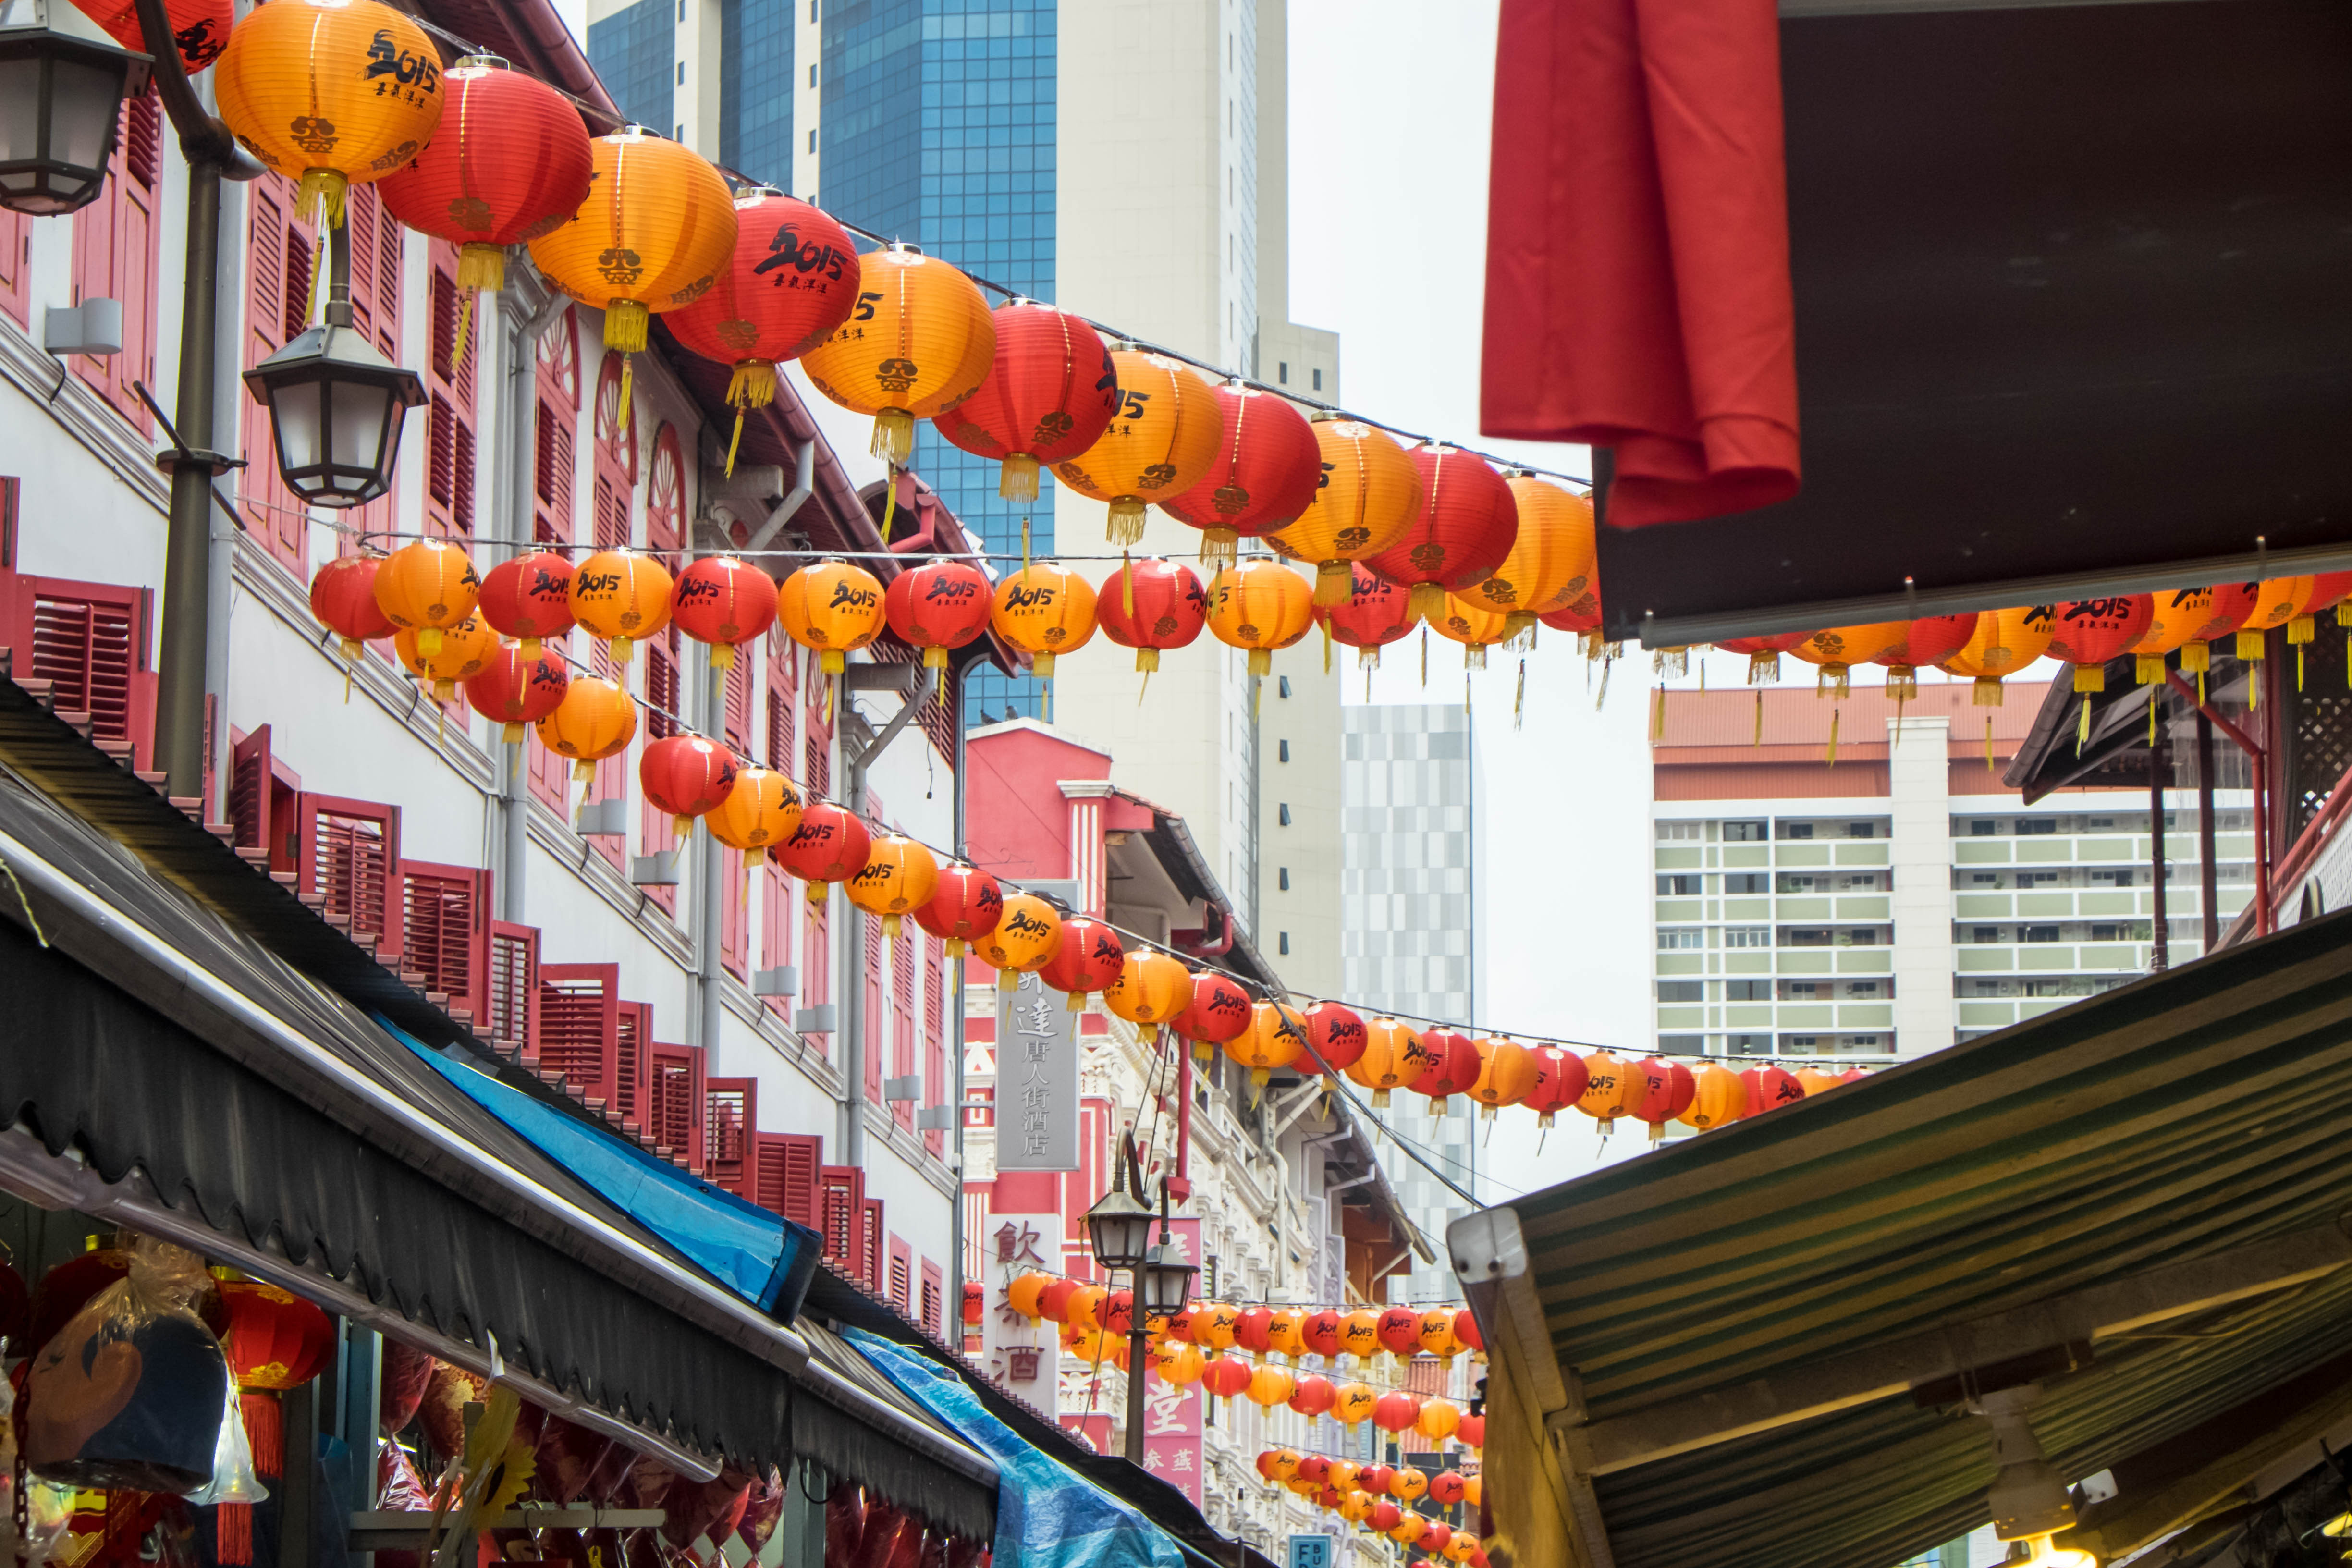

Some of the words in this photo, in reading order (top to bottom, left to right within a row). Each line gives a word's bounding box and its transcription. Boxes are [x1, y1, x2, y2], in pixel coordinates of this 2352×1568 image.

[366, 29, 439, 94] 2015
[754, 222, 848, 281] 2015
[828, 328, 865, 342] 洋洋
[1114, 390, 1151, 419] 15
[577, 569, 621, 598] 2015
[677, 573, 723, 607] 2015
[829, 579, 877, 608] 2015
[926, 575, 978, 600] 2015
[1005, 581, 1056, 612] 2015
[457, 616, 478, 632] 15
[1004, 908, 1051, 937] 2015
[1207, 987, 1246, 1012] 2015
[1328, 1017, 1362, 1043] 2015
[1426, 1052, 1443, 1066] 15
[1589, 1076, 1616, 1090] 015
[1647, 1076, 1663, 1089] 15
[1212, 1313, 1234, 1327] 201
[1315, 1320, 1337, 1336] 201
[1347, 1322, 1374, 1339] 2015
[1384, 1315, 1412, 1332] 2015
[1421, 1320, 1446, 1336] 2015
[1298, 1544, 1309, 1568] F
[1313, 1544, 1321, 1568] BU
